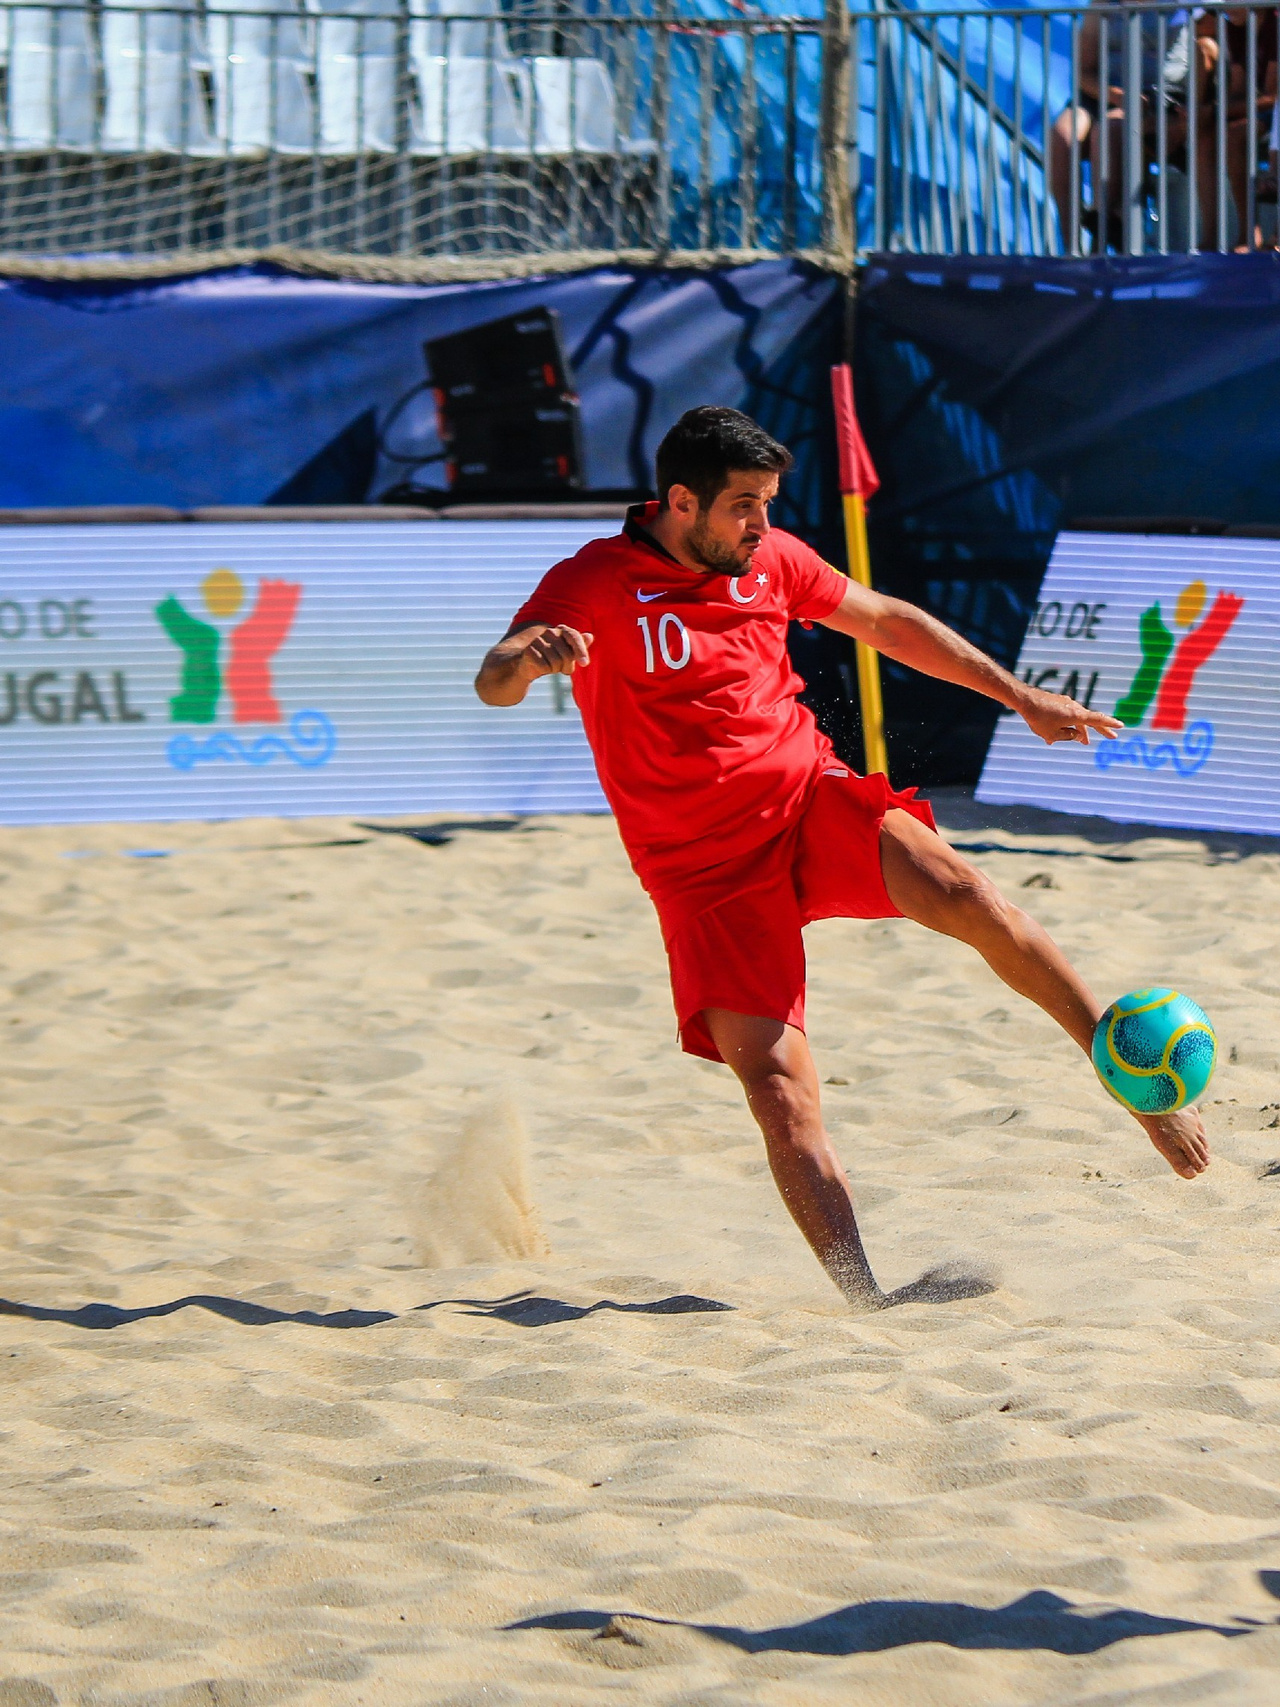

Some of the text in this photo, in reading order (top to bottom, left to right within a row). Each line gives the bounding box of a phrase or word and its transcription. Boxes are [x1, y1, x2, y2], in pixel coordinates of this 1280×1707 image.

[38, 599, 96, 639] DE
[1065, 602, 1107, 640] DE
[637, 612, 691, 674] 10
